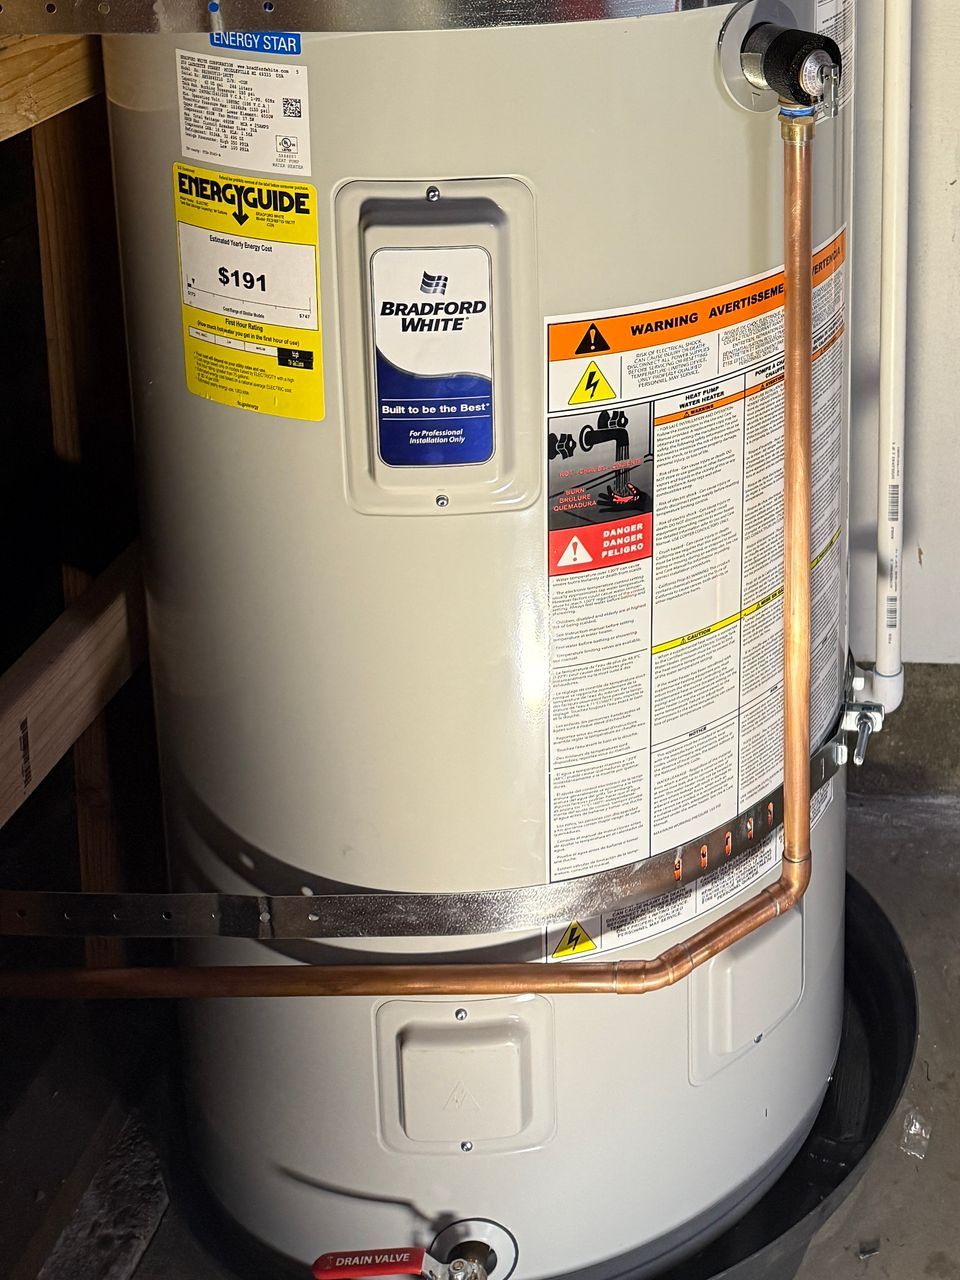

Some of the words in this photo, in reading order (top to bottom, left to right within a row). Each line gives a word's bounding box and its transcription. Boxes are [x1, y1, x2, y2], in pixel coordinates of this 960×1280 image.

[213, 32, 260, 49] ENERGY
[263, 35, 297, 52] STAR
[209, 235, 230, 246] Estimated
[230, 239, 244, 250] Yearly
[244, 242, 260, 252] Energy
[261, 244, 273, 253] Cost
[218, 266, 266, 292] $191
[380, 300, 487, 316] BRADFORD
[630, 312, 699, 336] WARNING
[708, 283, 784, 319] AVERTISSEME
[225, 318, 235, 327] First
[236, 320, 247, 329] Hour
[248, 322, 263, 333] Rating
[400, 317, 465, 333] WHITE
[679, 399, 700, 410] WATER
[701, 391, 725, 403] HEATER
[685, 392, 701, 401] HEAT
[702, 386, 720, 396] PUMP
[382, 405, 405, 414] Built
[408, 404, 419, 414] to
[422, 403, 436, 414] be
[439, 403, 457, 413] the
[690, 404, 714, 415] WARNING
[422, 428, 463, 437] Professional
[409, 436, 448, 445] Installation
[449, 436, 466, 445] Only
[565, 487, 585, 496] BURN
[553, 500, 597, 512] QUEMADURA
[603, 523, 643, 538] DANGER
[603, 533, 643, 548] DANGER
[601, 543, 644, 559] PELIGRO
[687, 628, 712, 641] CAUTION
[688, 726, 707, 738] NOTICE
[336, 1255, 373, 1266] DRAIN
[375, 1253, 411, 1264] VALVE
